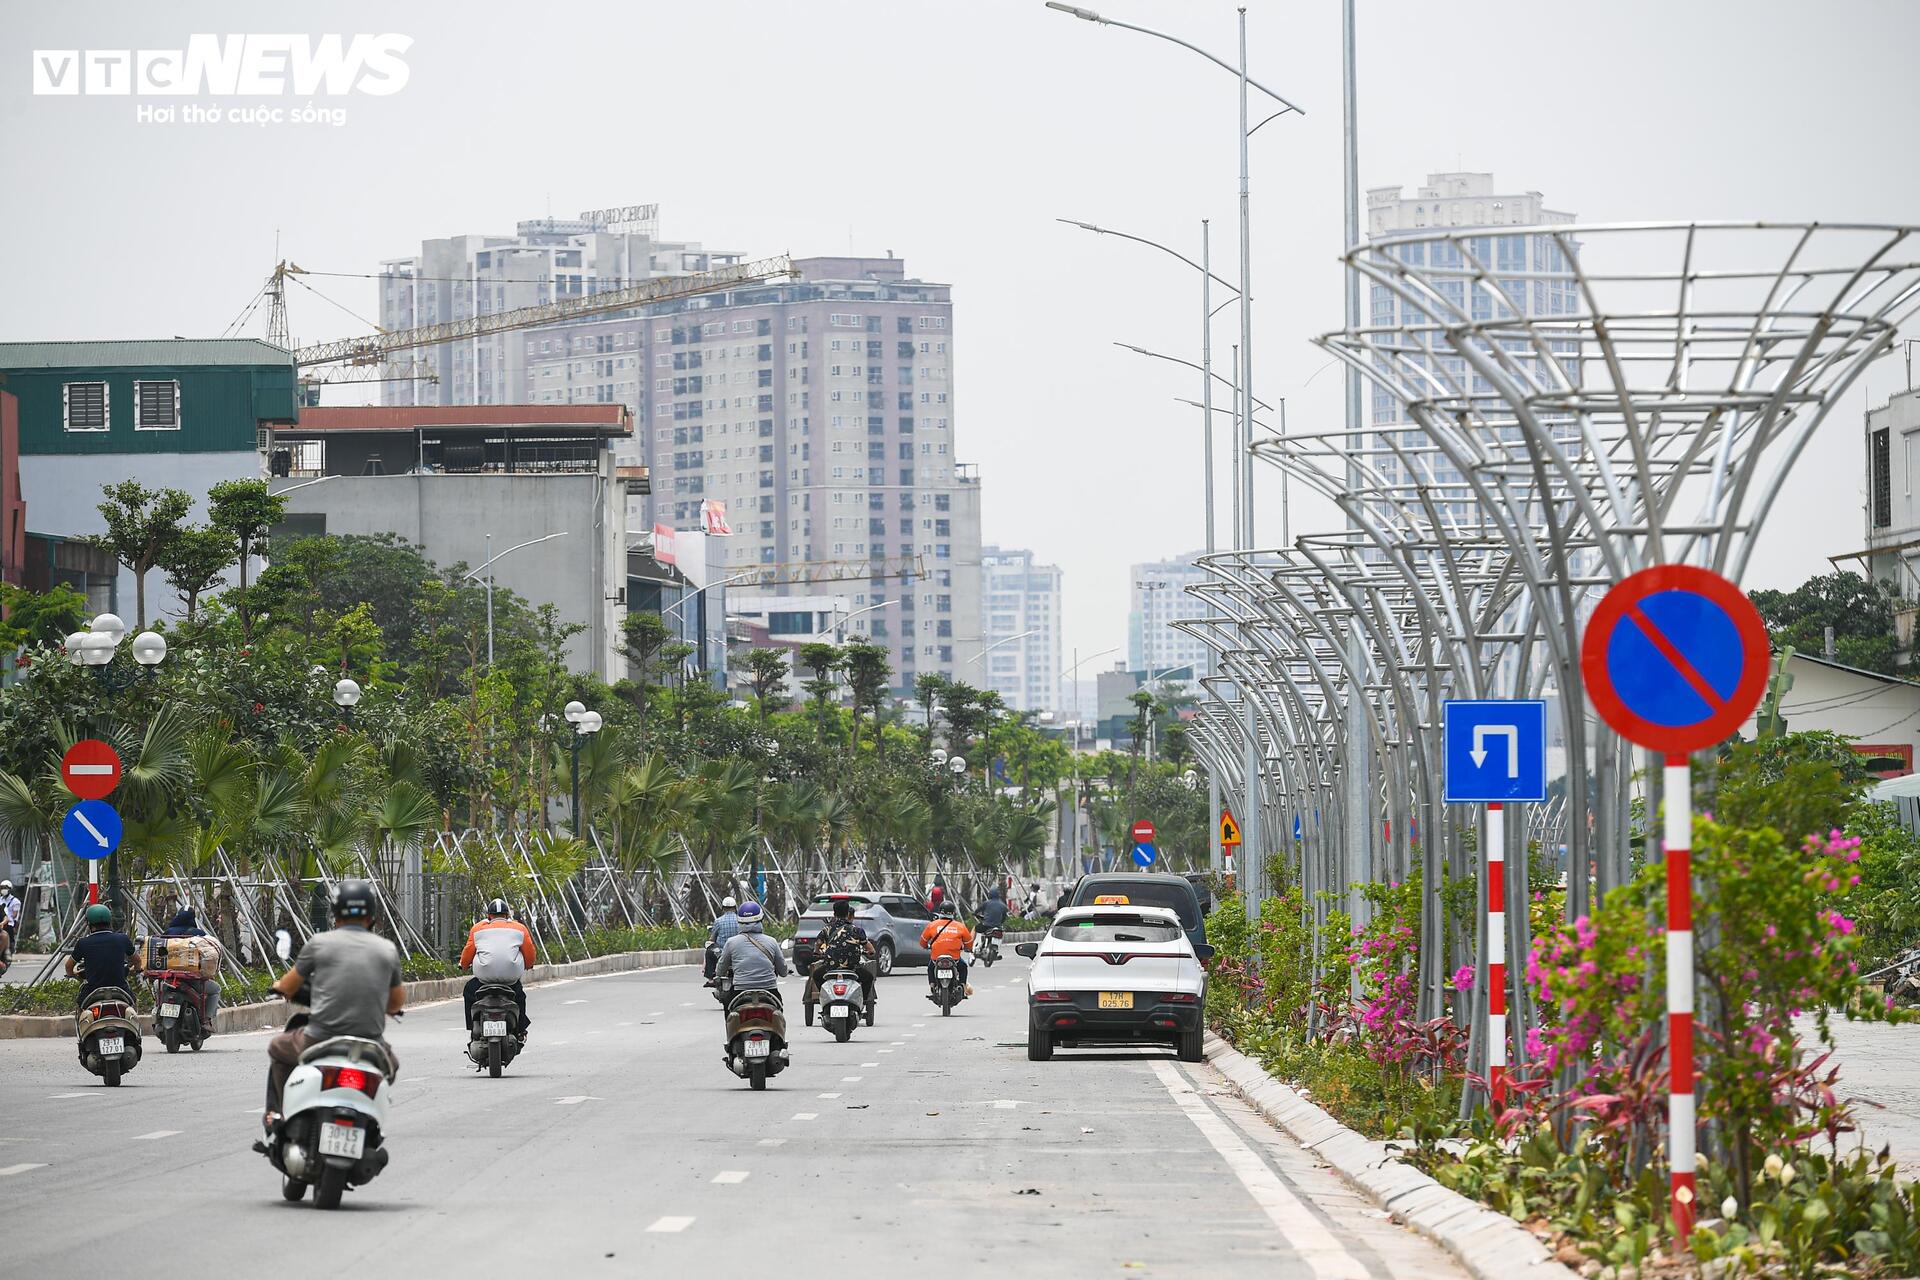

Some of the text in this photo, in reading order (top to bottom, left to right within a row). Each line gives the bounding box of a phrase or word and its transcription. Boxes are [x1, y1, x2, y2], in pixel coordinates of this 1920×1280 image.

[1109, 992, 1124, 1000] 17H
[1102, 1000, 1130, 1008] 025.76
[327, 1126, 359, 1142] 30-L5
[326, 1140, 356, 1155] 1844
